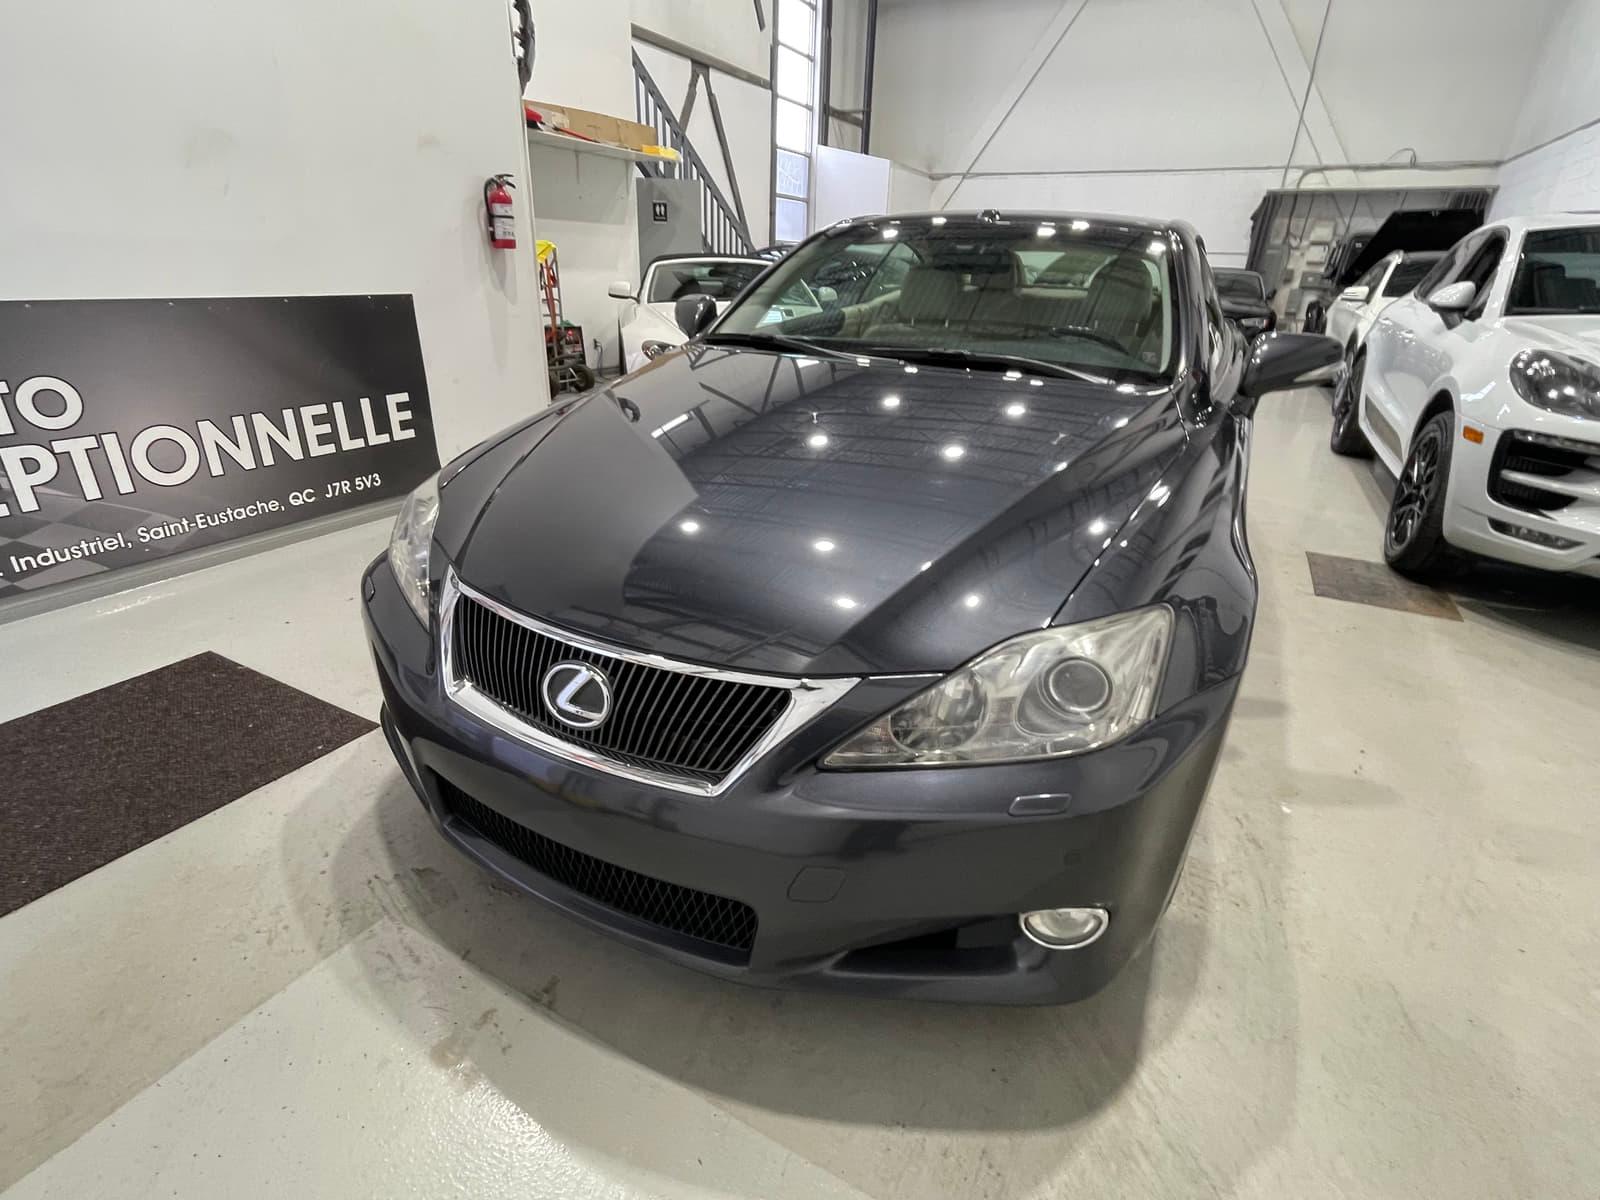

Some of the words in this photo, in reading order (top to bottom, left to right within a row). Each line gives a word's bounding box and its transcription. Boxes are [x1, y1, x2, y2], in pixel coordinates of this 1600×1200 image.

[0, 392, 416, 517] PTIONNELLE
[10, 532, 132, 573] Industriel,
[137, 500, 285, 543] Saint-Eustache,
[288, 487, 316, 507] QC
[324, 480, 352, 498] J7R
[355, 473, 382, 491] 5V3
